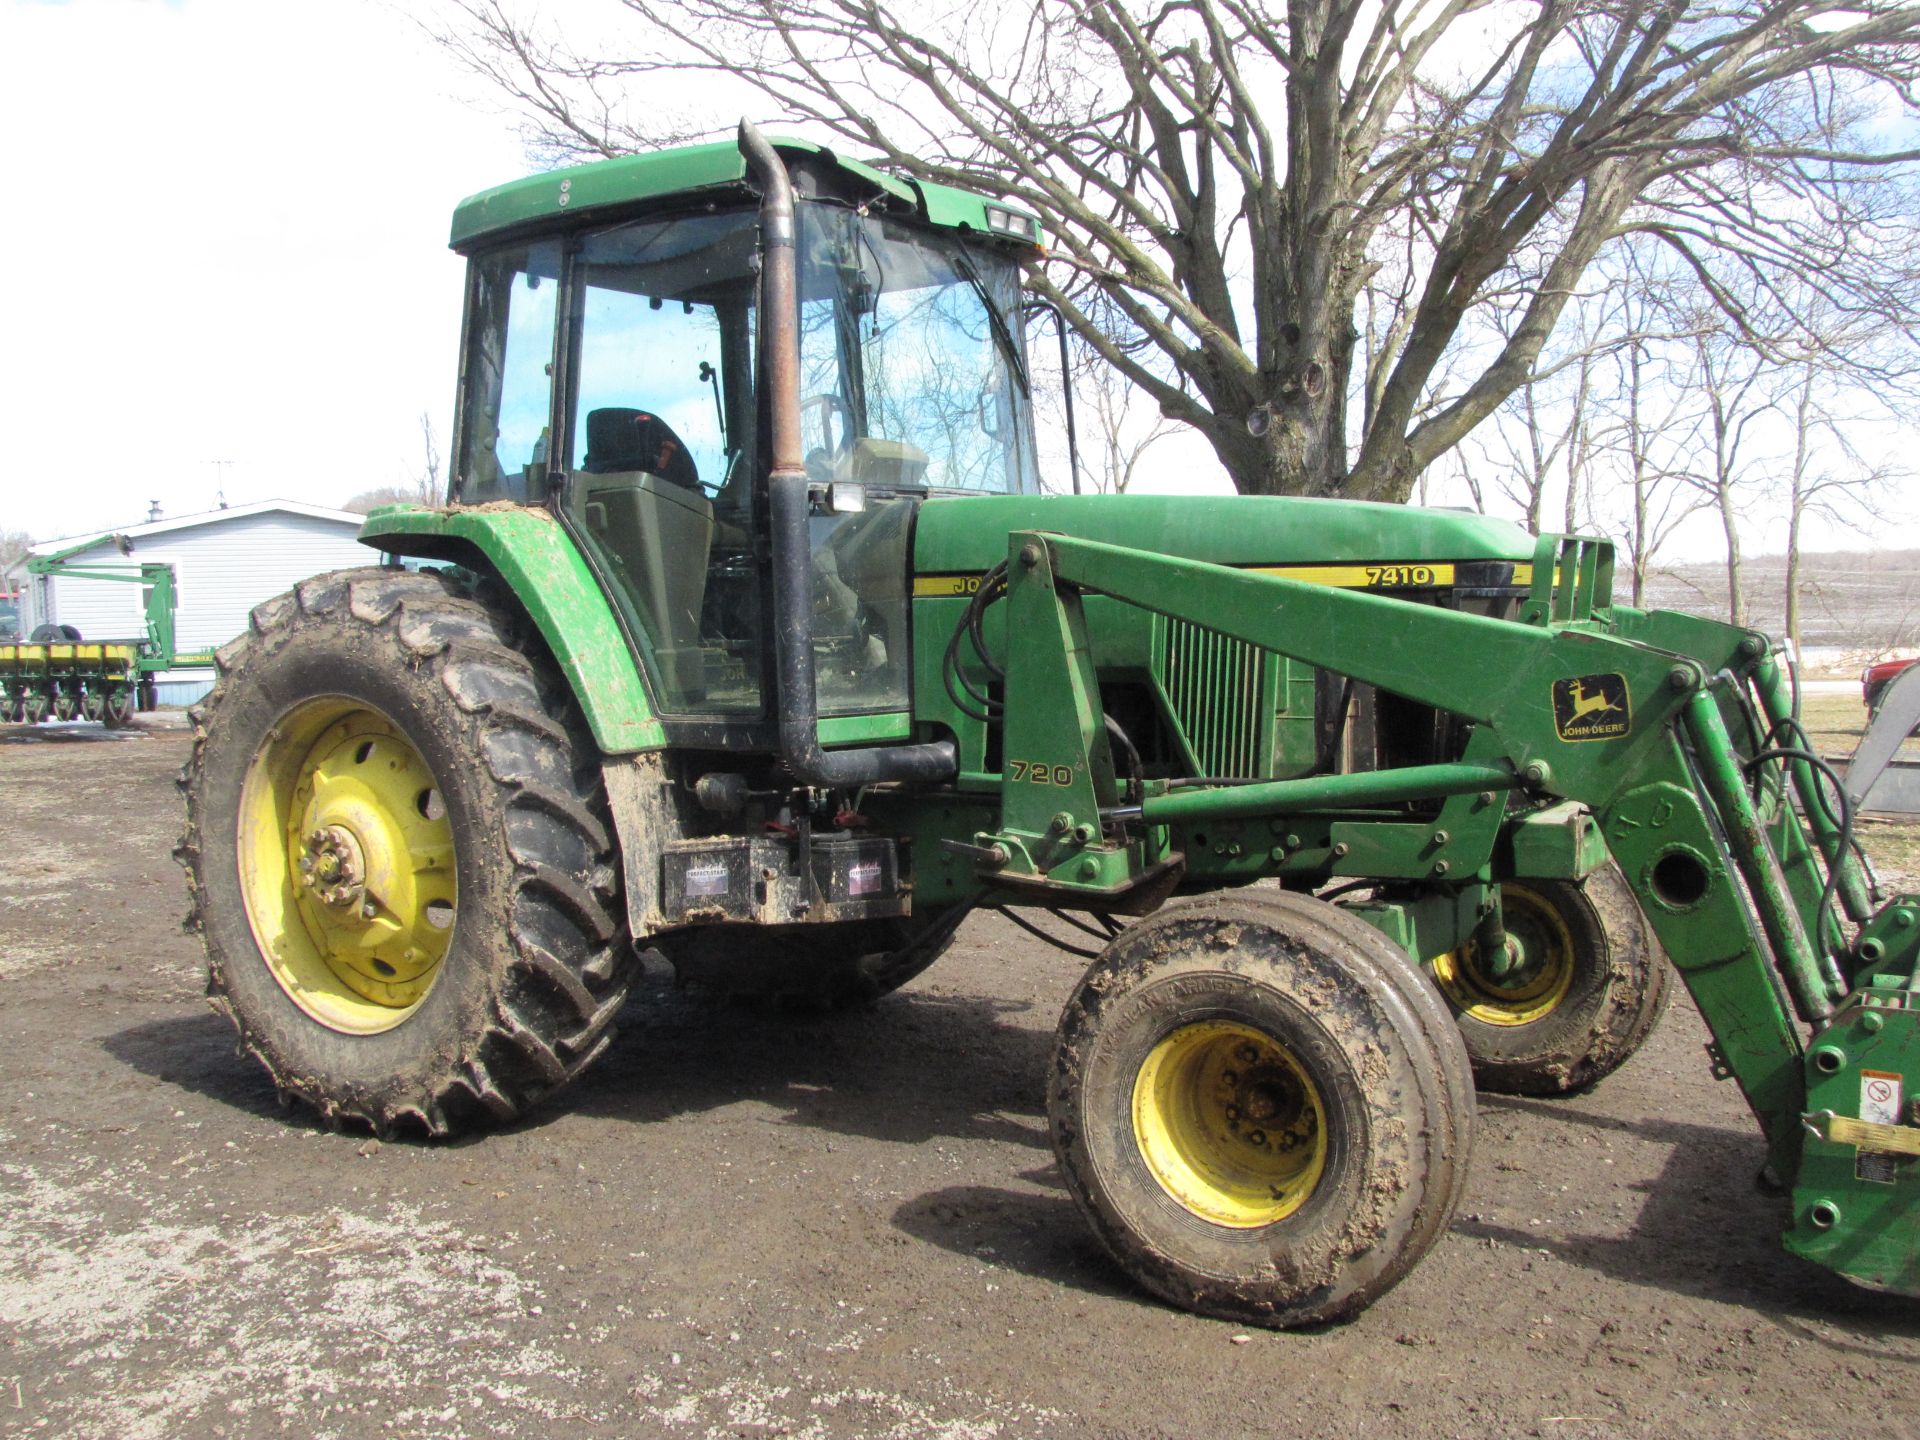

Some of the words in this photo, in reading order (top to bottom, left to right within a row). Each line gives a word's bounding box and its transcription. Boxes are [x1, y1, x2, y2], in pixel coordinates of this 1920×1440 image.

[1366, 566, 1433, 586] 7410
[1562, 726, 1590, 737] JOHN
[1591, 723, 1625, 734] DEERE
[1009, 760, 1073, 787] 720
